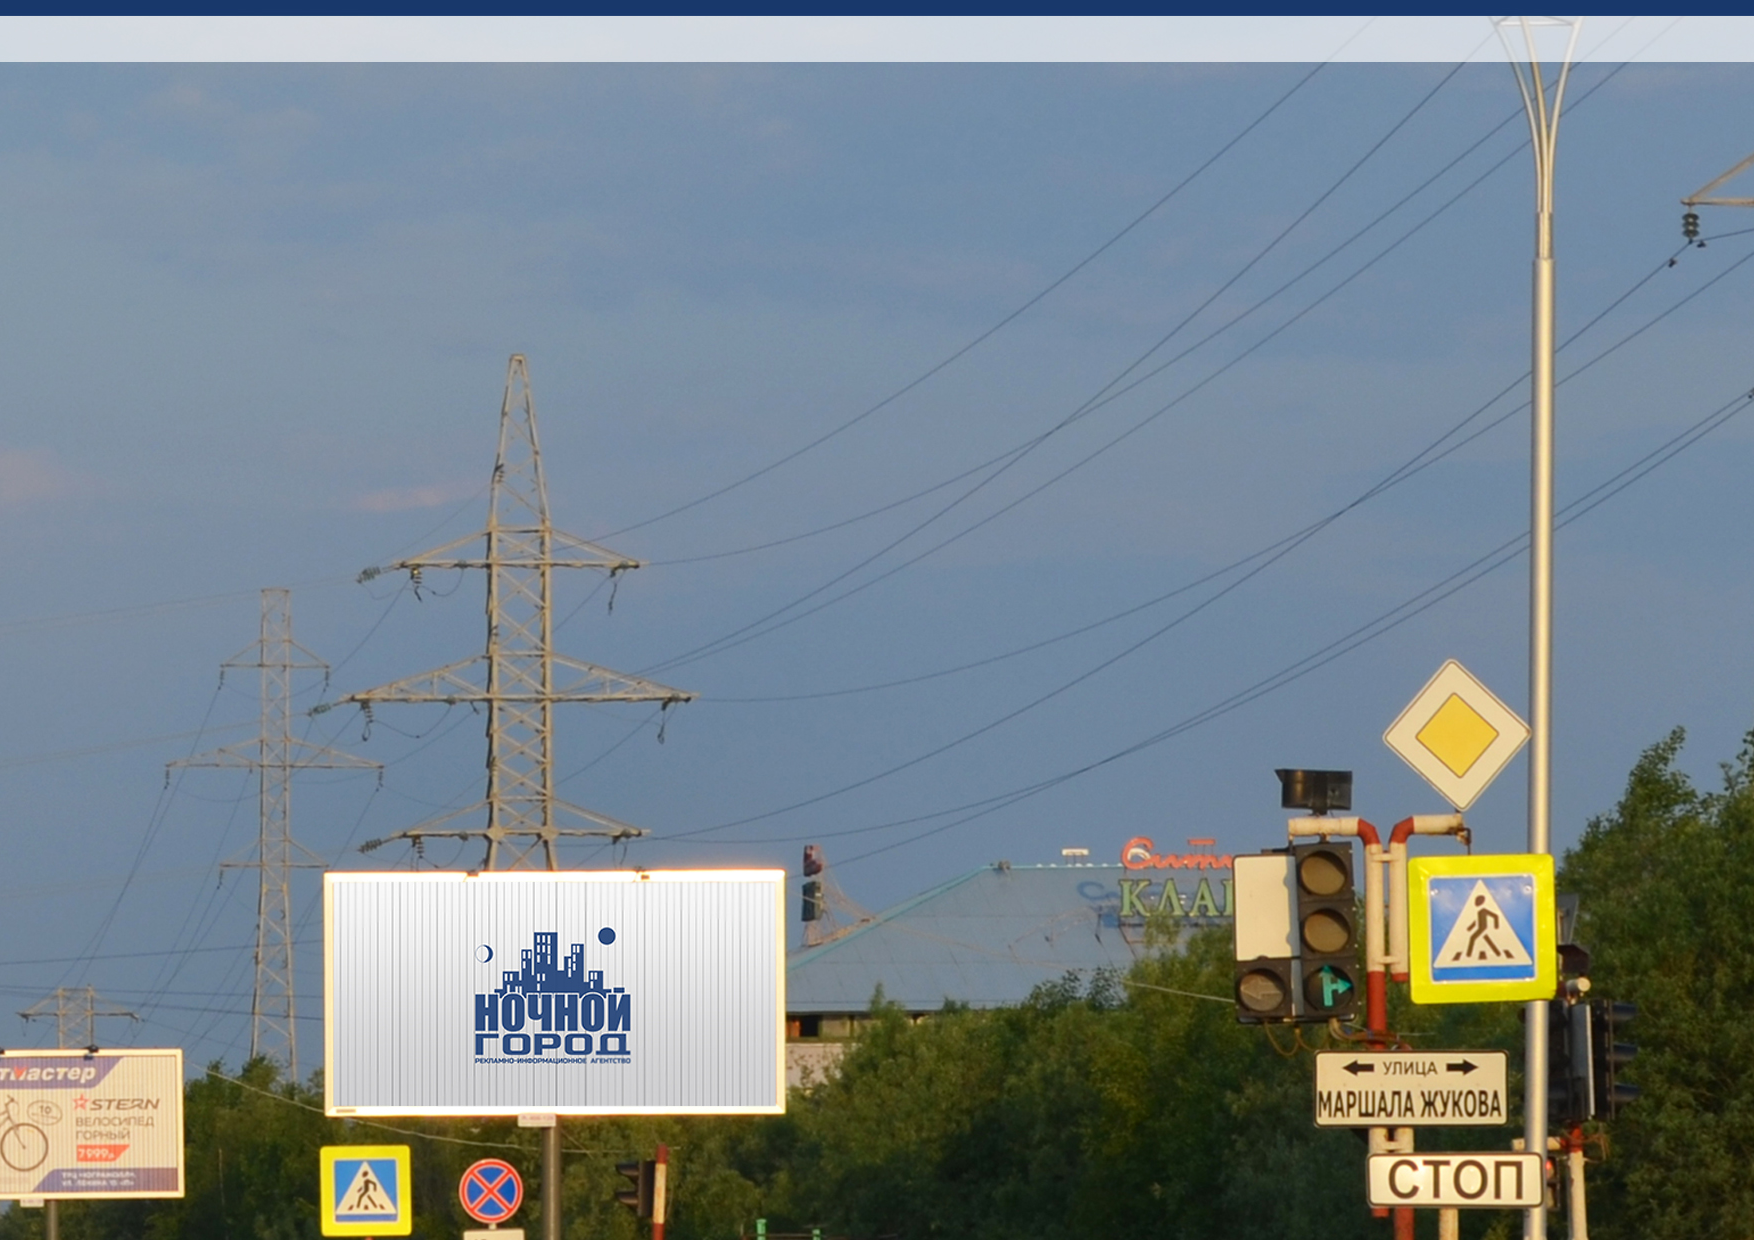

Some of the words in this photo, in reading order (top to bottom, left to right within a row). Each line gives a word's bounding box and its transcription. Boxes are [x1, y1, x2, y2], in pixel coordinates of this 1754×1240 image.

[475, 987, 631, 1032] НОЧНОЙ
[475, 1033, 631, 1056] ГОРОД
[474, 1057, 588, 1065] РЕКЛАМНО-ИНФОРМАЦИОННОЕ
[590, 1057, 632, 1065] АГЕНТСТВО
[1382, 1061, 1439, 1078] УЛИЦА
[90, 1098, 160, 1111] STERN
[1318, 1090, 1416, 1119] МАРШАЛА
[1420, 1090, 1503, 1118] ЖУКОВА
[76, 1116, 155, 1128] ВЕЛОСИПЕД
[76, 1127, 131, 1140] ГОРНЫЙ
[1388, 1159, 1524, 1200] СТОП
